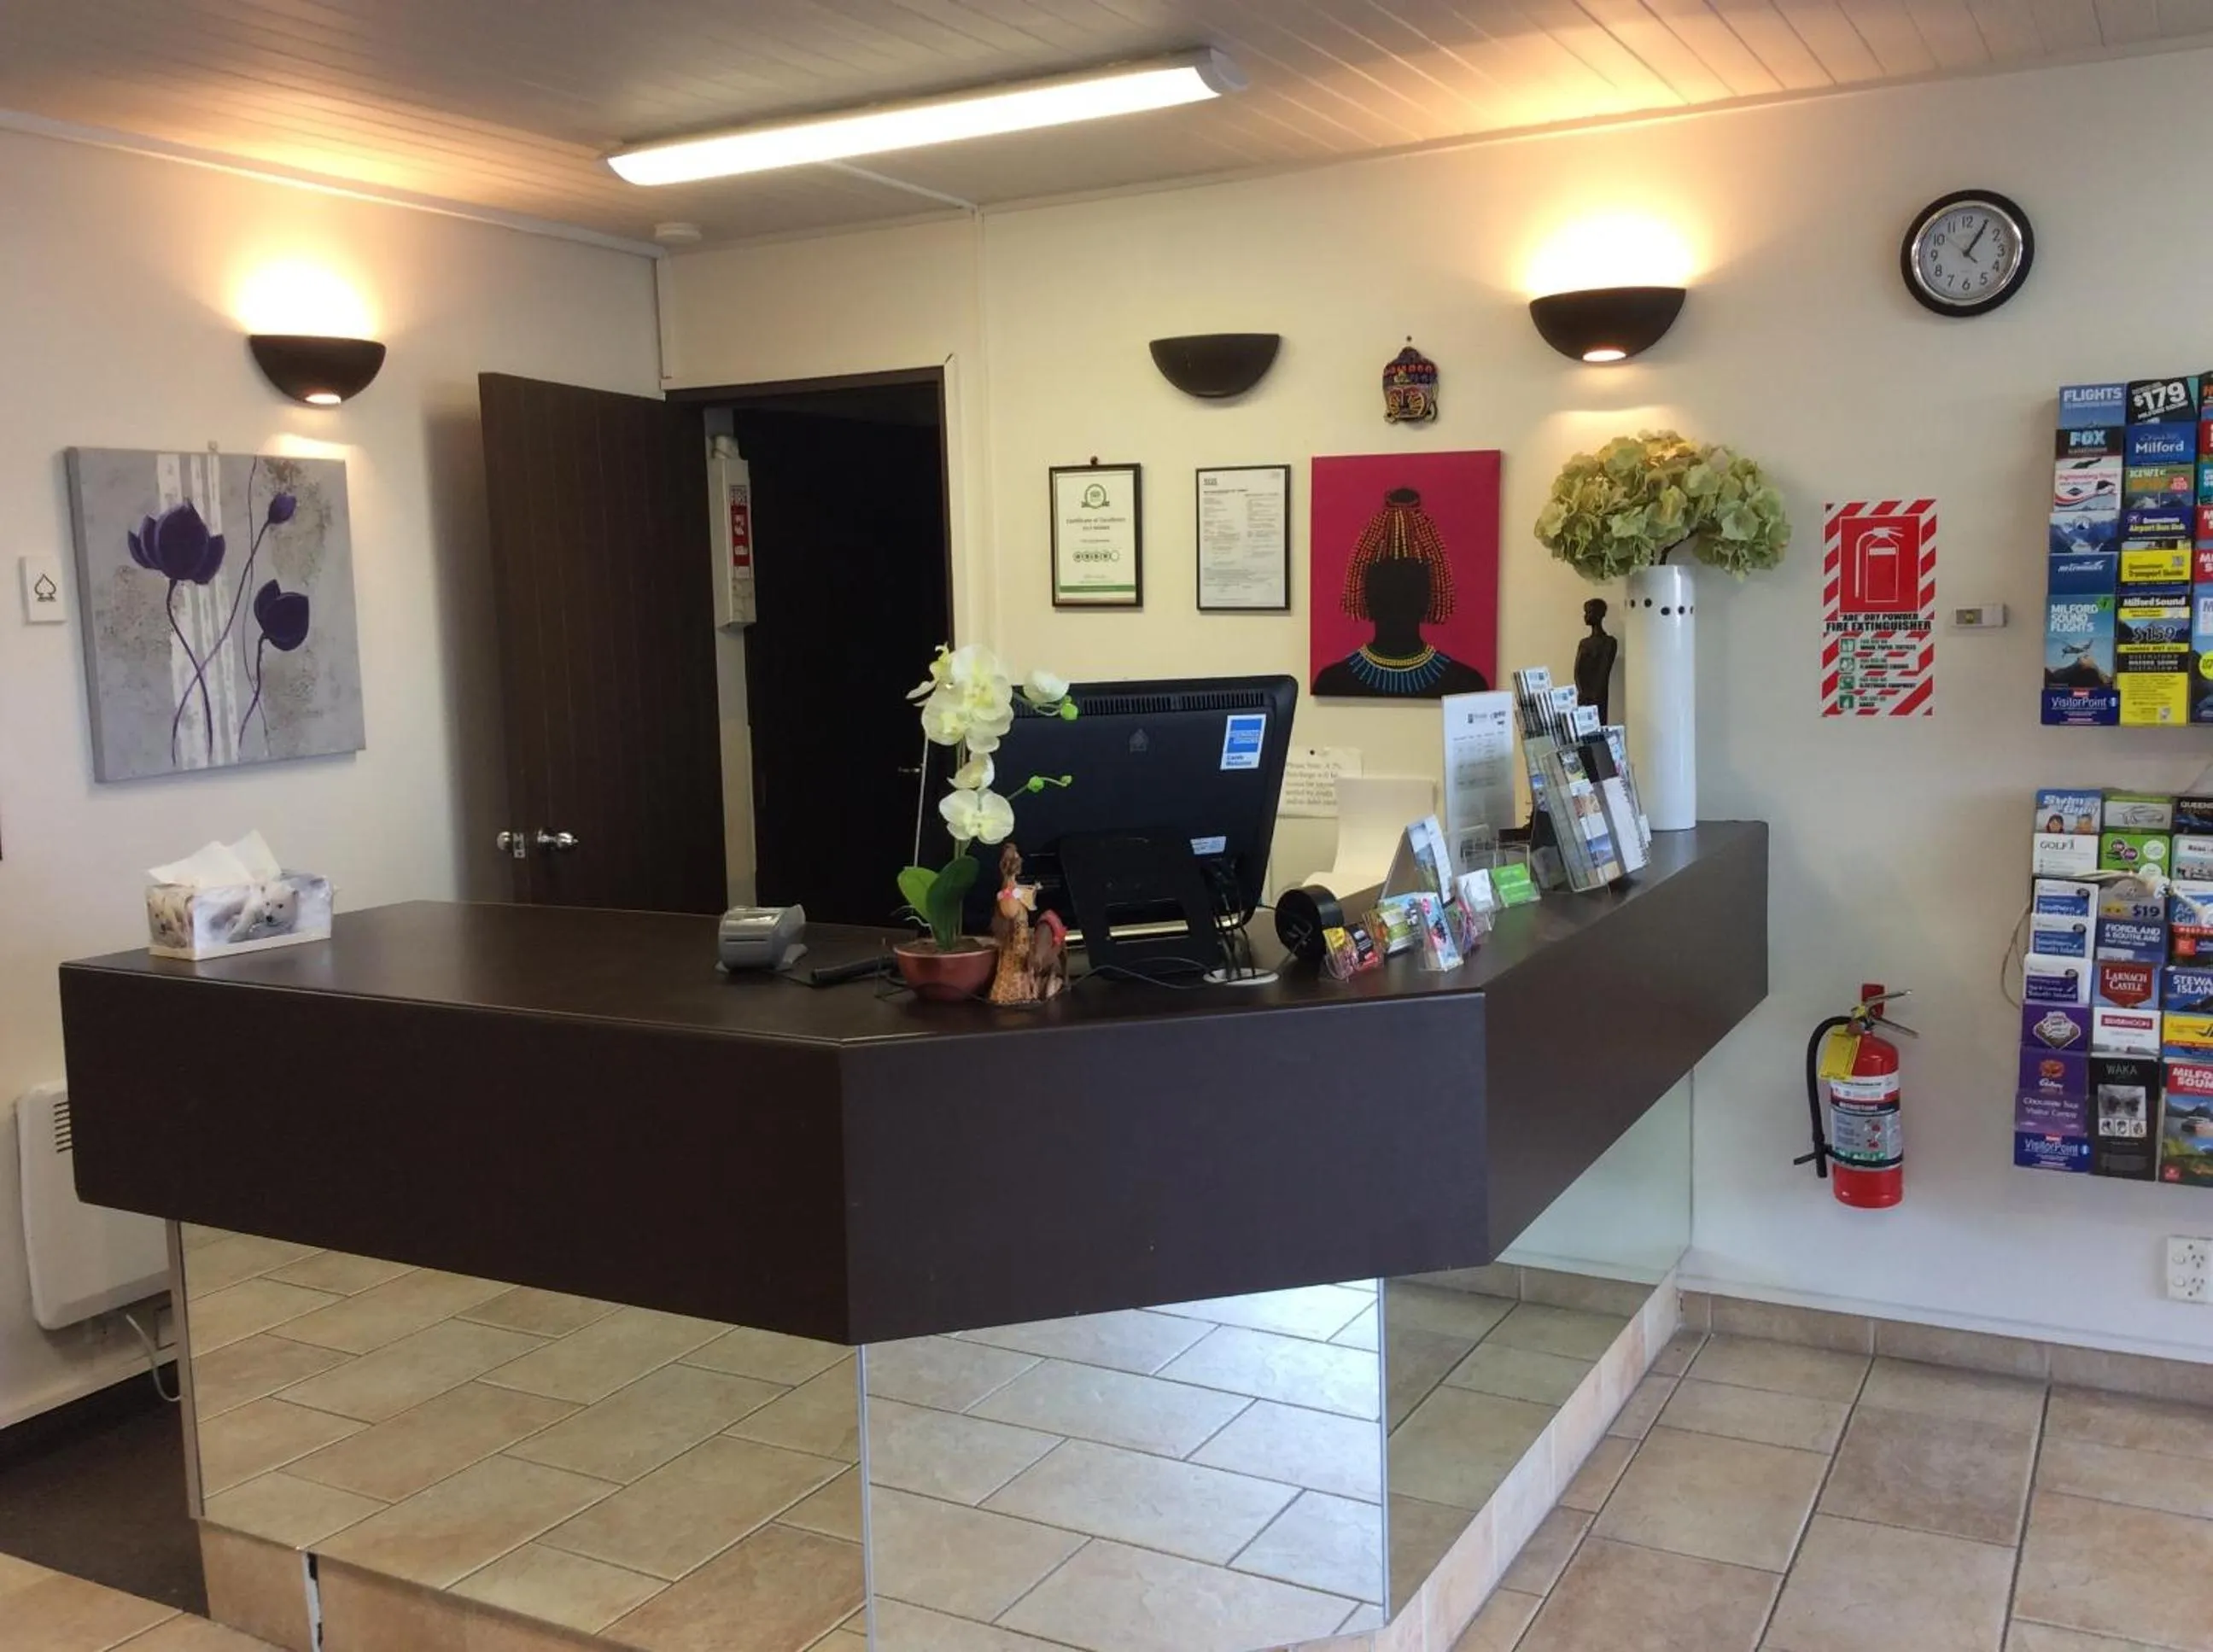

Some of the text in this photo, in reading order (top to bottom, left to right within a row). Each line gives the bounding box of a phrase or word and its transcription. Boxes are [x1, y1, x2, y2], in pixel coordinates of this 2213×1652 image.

[1947, 222, 1956, 233] 11
[1962, 215, 1974, 229] 12
[1934, 234, 1945, 246] 10
[1993, 229, 2001, 242] 2
[1930, 249, 1938, 262] 9
[1997, 244, 2005, 257] 3
[1935, 265, 1942, 277] 8
[1993, 260, 2000, 271] 4
[1947, 275, 1955, 287] 7
[1962, 277, 1971, 290] 6
[1980, 272, 1988, 285] 5
[2064, 388, 2122, 402] FLIGHTS
[2134, 382, 2187, 411] $179
[2070, 430, 2105, 447] FOX
[2135, 441, 2184, 454] Milford
[2123, 597, 2186, 606] Milford Sound
[2051, 604, 2099, 614] MILFORD
[2051, 613, 2087, 622] SOUND
[1826, 620, 1931, 632] FIRE EXTINGUISHER
[2051, 622, 2094, 633] FLIGHTS
[2052, 697, 2107, 708] VisitorPoint
[2132, 903, 2161, 918] $19
[2105, 924, 2161, 936] FIORDLAND
[2105, 969, 2148, 983] LARNACH
[2109, 981, 2143, 992] CASTLE
[2105, 1064, 2138, 1075] WAKA
[2025, 1138, 2078, 1156] VisitorPoint
